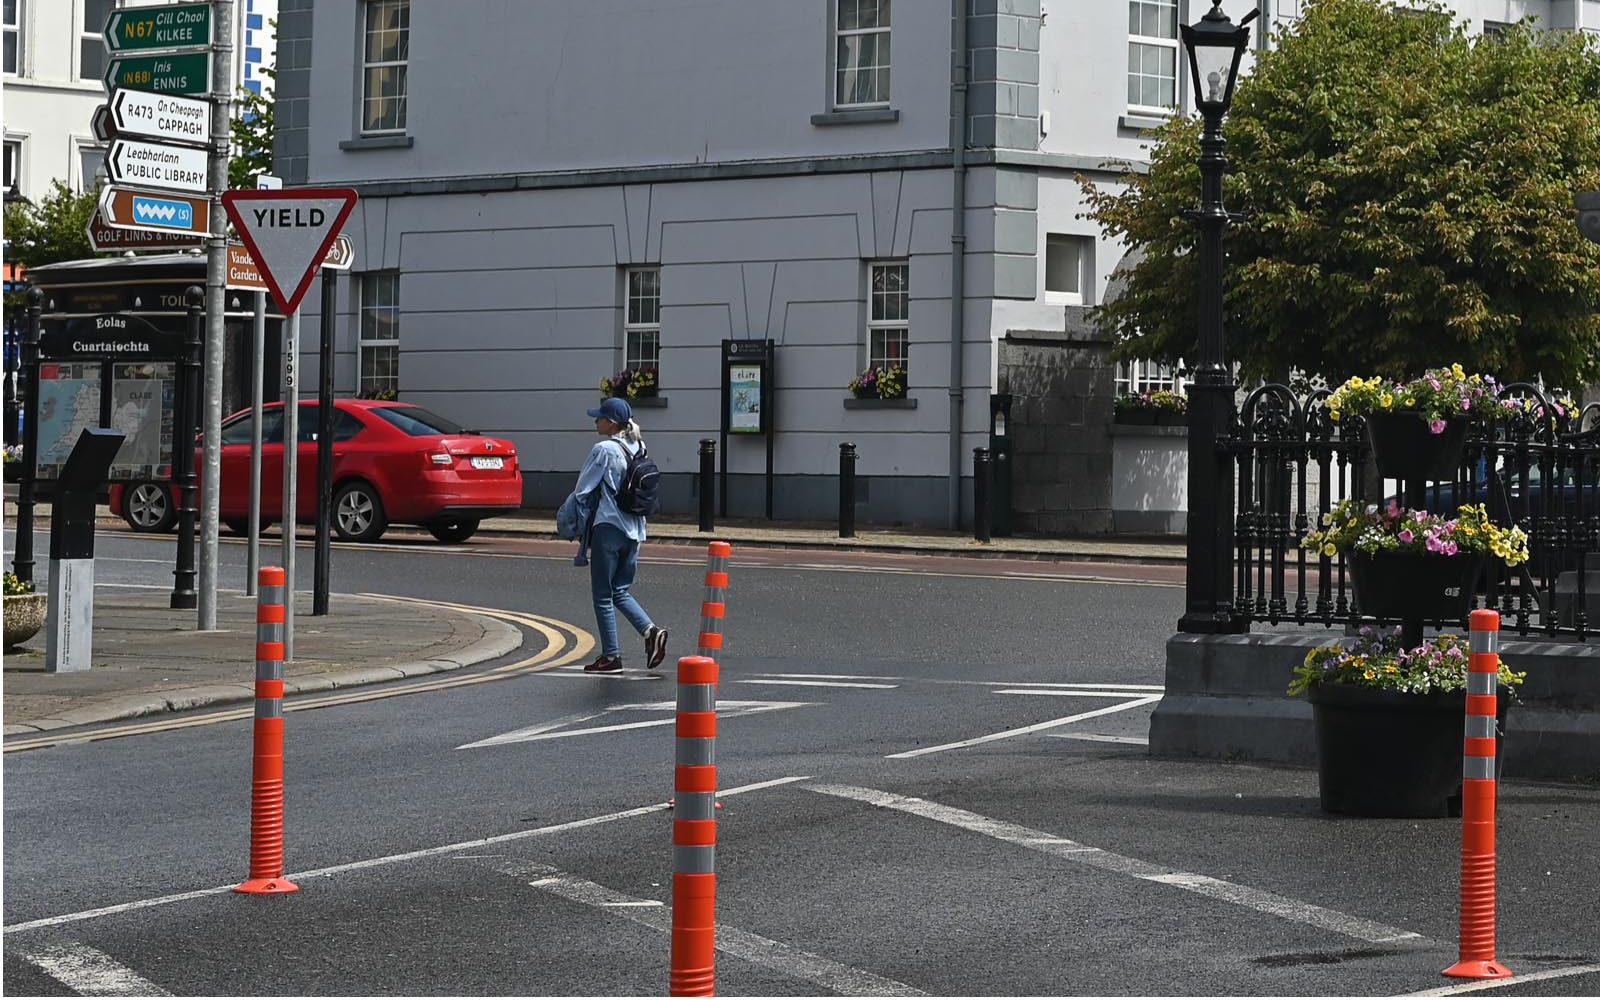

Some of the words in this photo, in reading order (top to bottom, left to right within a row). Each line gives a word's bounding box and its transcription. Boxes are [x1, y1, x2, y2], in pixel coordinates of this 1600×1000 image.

[156, 13, 173, 25] Cill
[126, 21, 154, 38] N67
[156, 28, 192, 42] KILKEE
[154, 62, 171, 73] Inis
[153, 77, 187, 90] ENNIS
[128, 104, 153, 119] R473
[158, 118, 202, 135] CAPPAGH
[127, 146, 179, 165] Leabharlann
[126, 164, 161, 180] PUBLIC
[164, 167, 204, 184] LIBRARY
[253, 209, 325, 227] YIELD
[97, 231, 121, 242] GOLF
[125, 232, 152, 242] LINKS
[231, 251, 255, 265] Vande
[231, 267, 257, 281] Garden
[96, 317, 126, 328] Eolas
